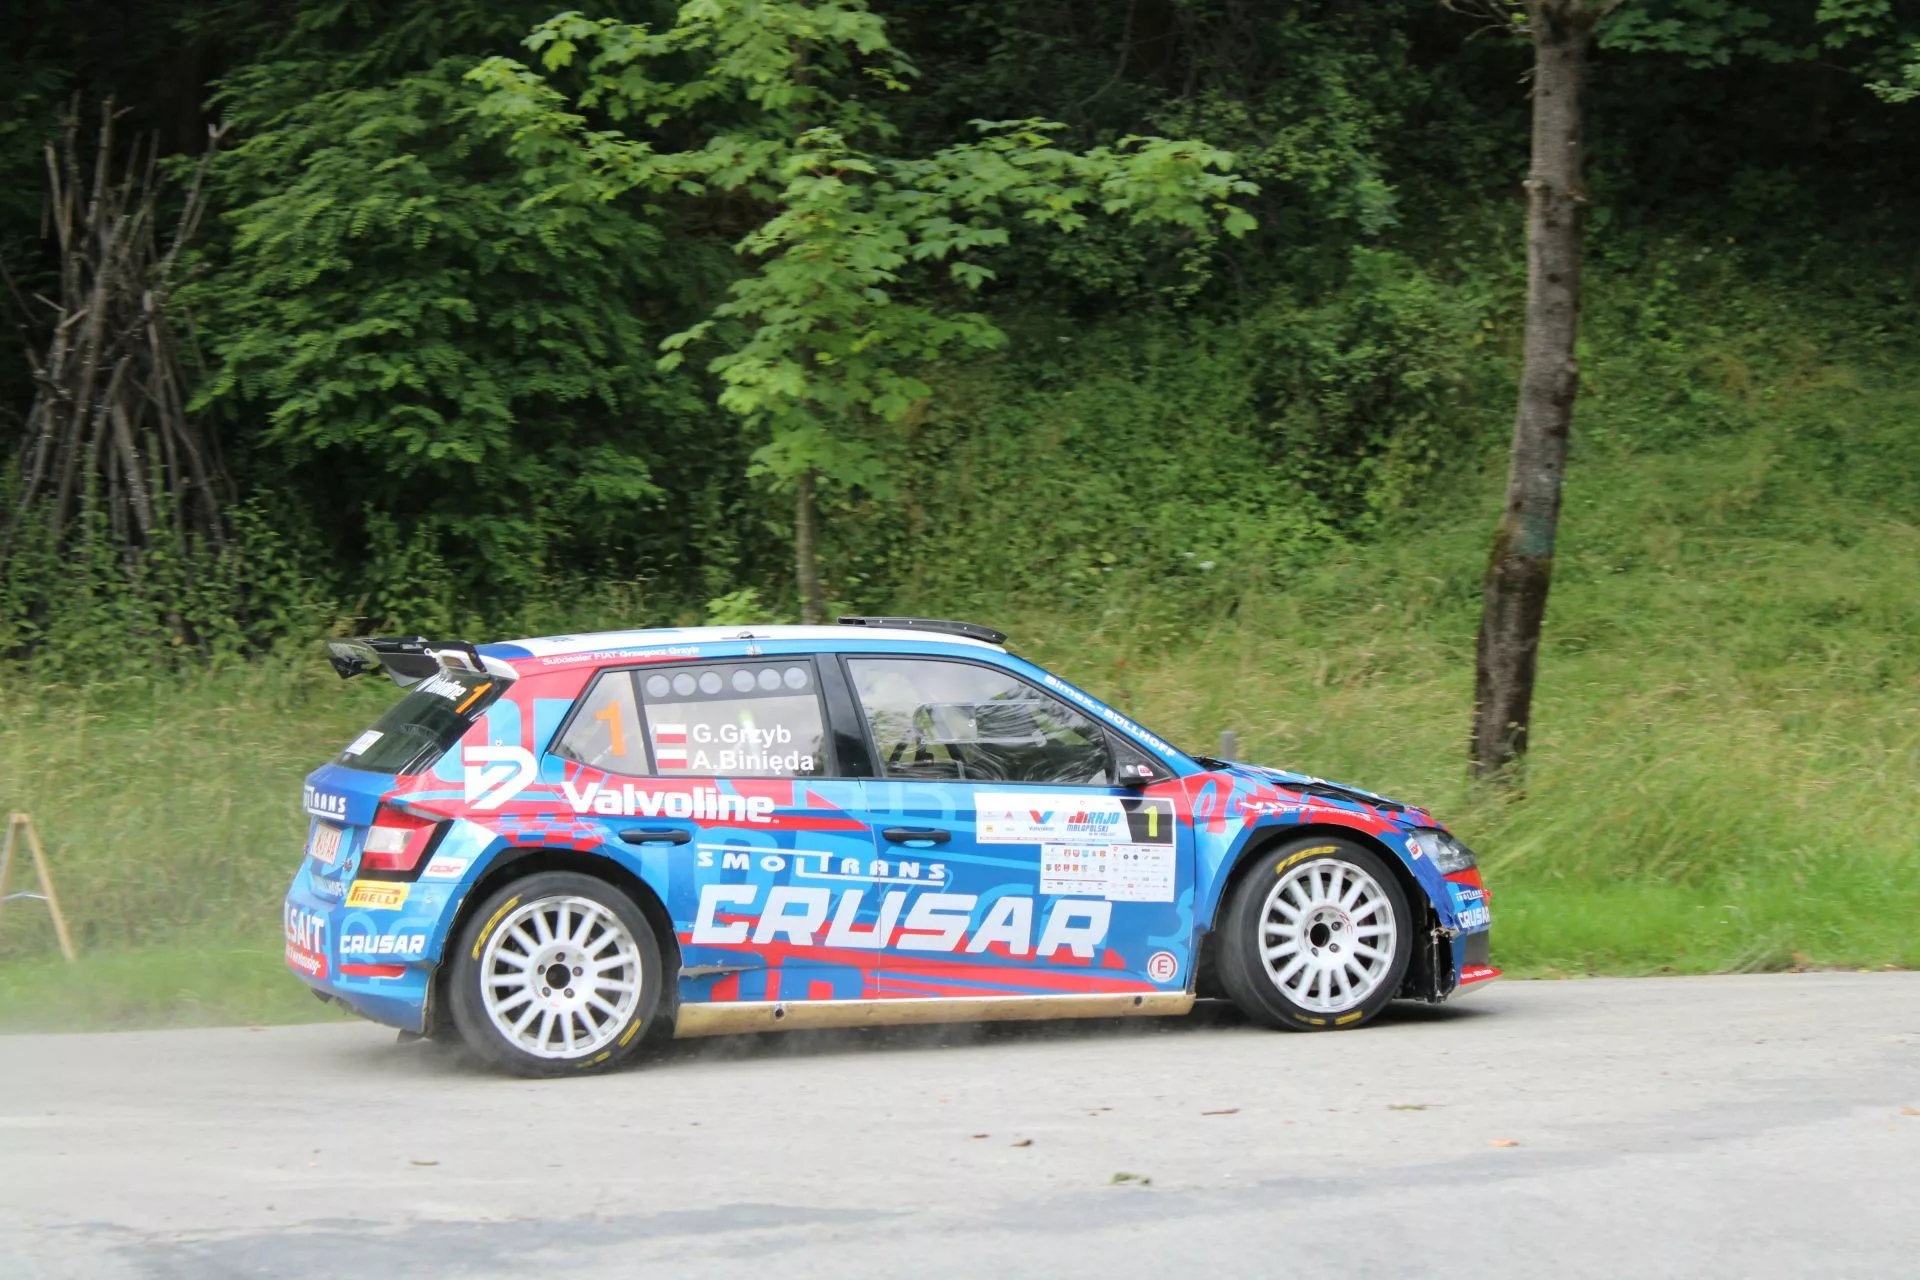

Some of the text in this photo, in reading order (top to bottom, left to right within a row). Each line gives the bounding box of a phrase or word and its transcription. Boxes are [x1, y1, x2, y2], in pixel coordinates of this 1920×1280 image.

[594, 652, 616, 660] FIAT
[455, 682, 493, 715] 1
[594, 699, 626, 757] 1
[692, 724, 791, 749] G.Grzyb
[560, 781, 776, 824] Valvoline
[1144, 805, 1158, 837] 1
[697, 844, 946, 887] SMOLTRANS
[350, 886, 401, 905] PIRELLI
[691, 884, 1112, 958] CRUSAR
[339, 934, 426, 955] CRUSAR
[1157, 959, 1168, 974] E
